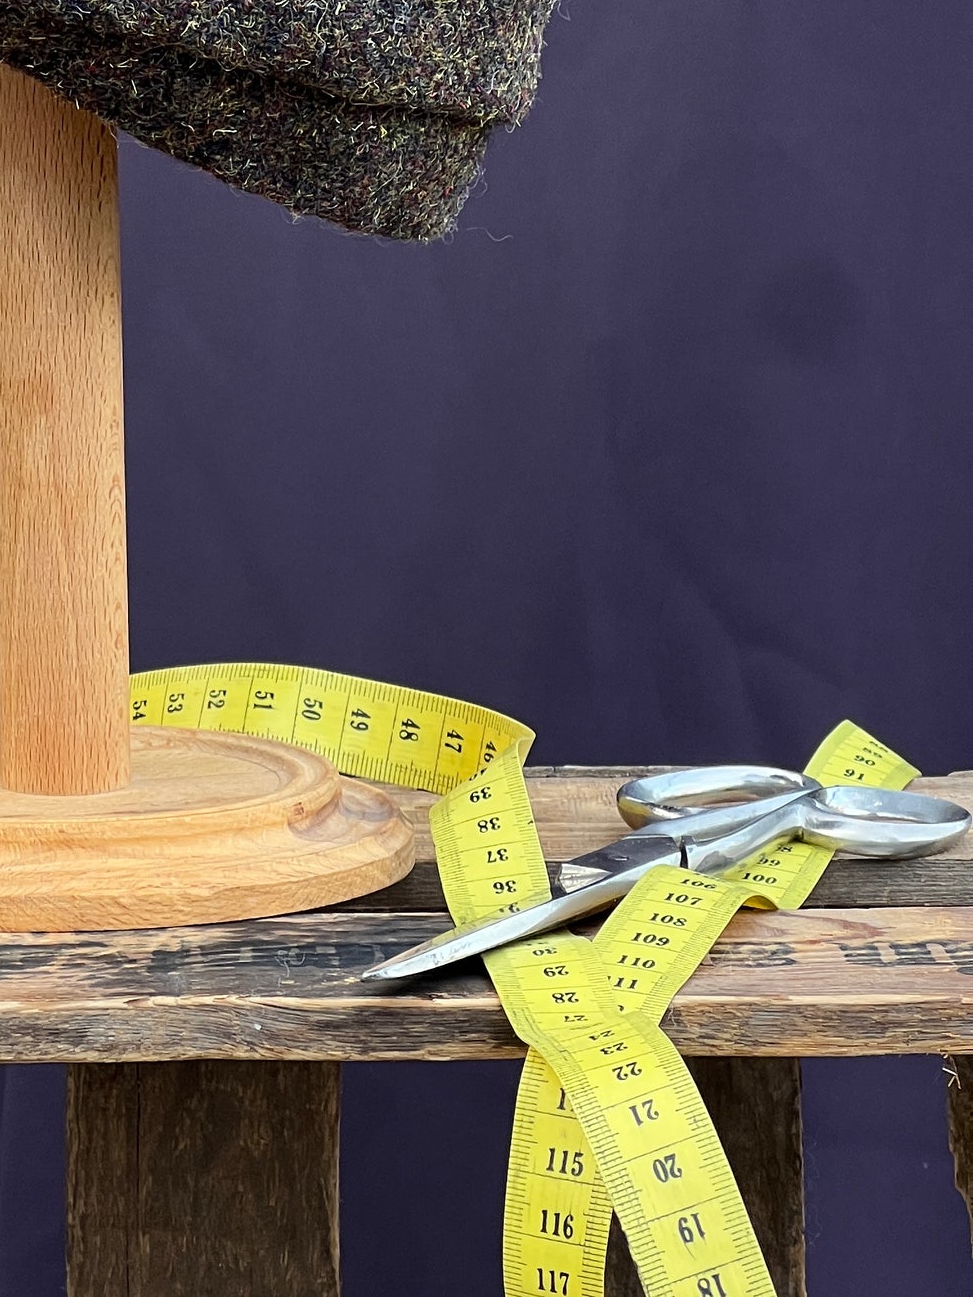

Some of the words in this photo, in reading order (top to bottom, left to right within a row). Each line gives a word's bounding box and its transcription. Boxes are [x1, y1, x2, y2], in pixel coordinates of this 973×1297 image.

[166, 693, 185, 714] 53
[208, 689, 227, 710] 52
[252, 689, 274, 710] 51
[132, 699, 147, 721] 54
[301, 696, 324, 721] 50
[350, 708, 372, 732] 49
[399, 717, 421, 742] 48
[444, 729, 465, 754] 47
[483, 740, 498, 763] 46
[854, 755, 876, 766] 90
[843, 768, 865, 781] 91
[469, 786, 492, 803] 39
[477, 817, 501, 834] 38
[487, 848, 509, 863] 37
[680, 878, 717, 890] 106
[742, 871, 778, 885] 100
[493, 880, 517, 895] 36
[664, 892, 703, 906] 107
[649, 912, 687, 927] 108
[631, 932, 670, 946] 109
[532, 947, 558, 956] 30
[617, 955, 656, 969] 110
[543, 965, 570, 978] 29
[607, 975, 638, 990] 11
[552, 991, 580, 1004] 28
[600, 1042, 628, 1055] 23
[612, 1062, 643, 1081] 22
[629, 1099, 659, 1127] 21
[546, 1147, 584, 1177] 115
[652, 1153, 683, 1183] 20
[540, 1209, 574, 1239] 116
[677, 1212, 706, 1243] 19
[537, 1268, 570, 1297] 117
